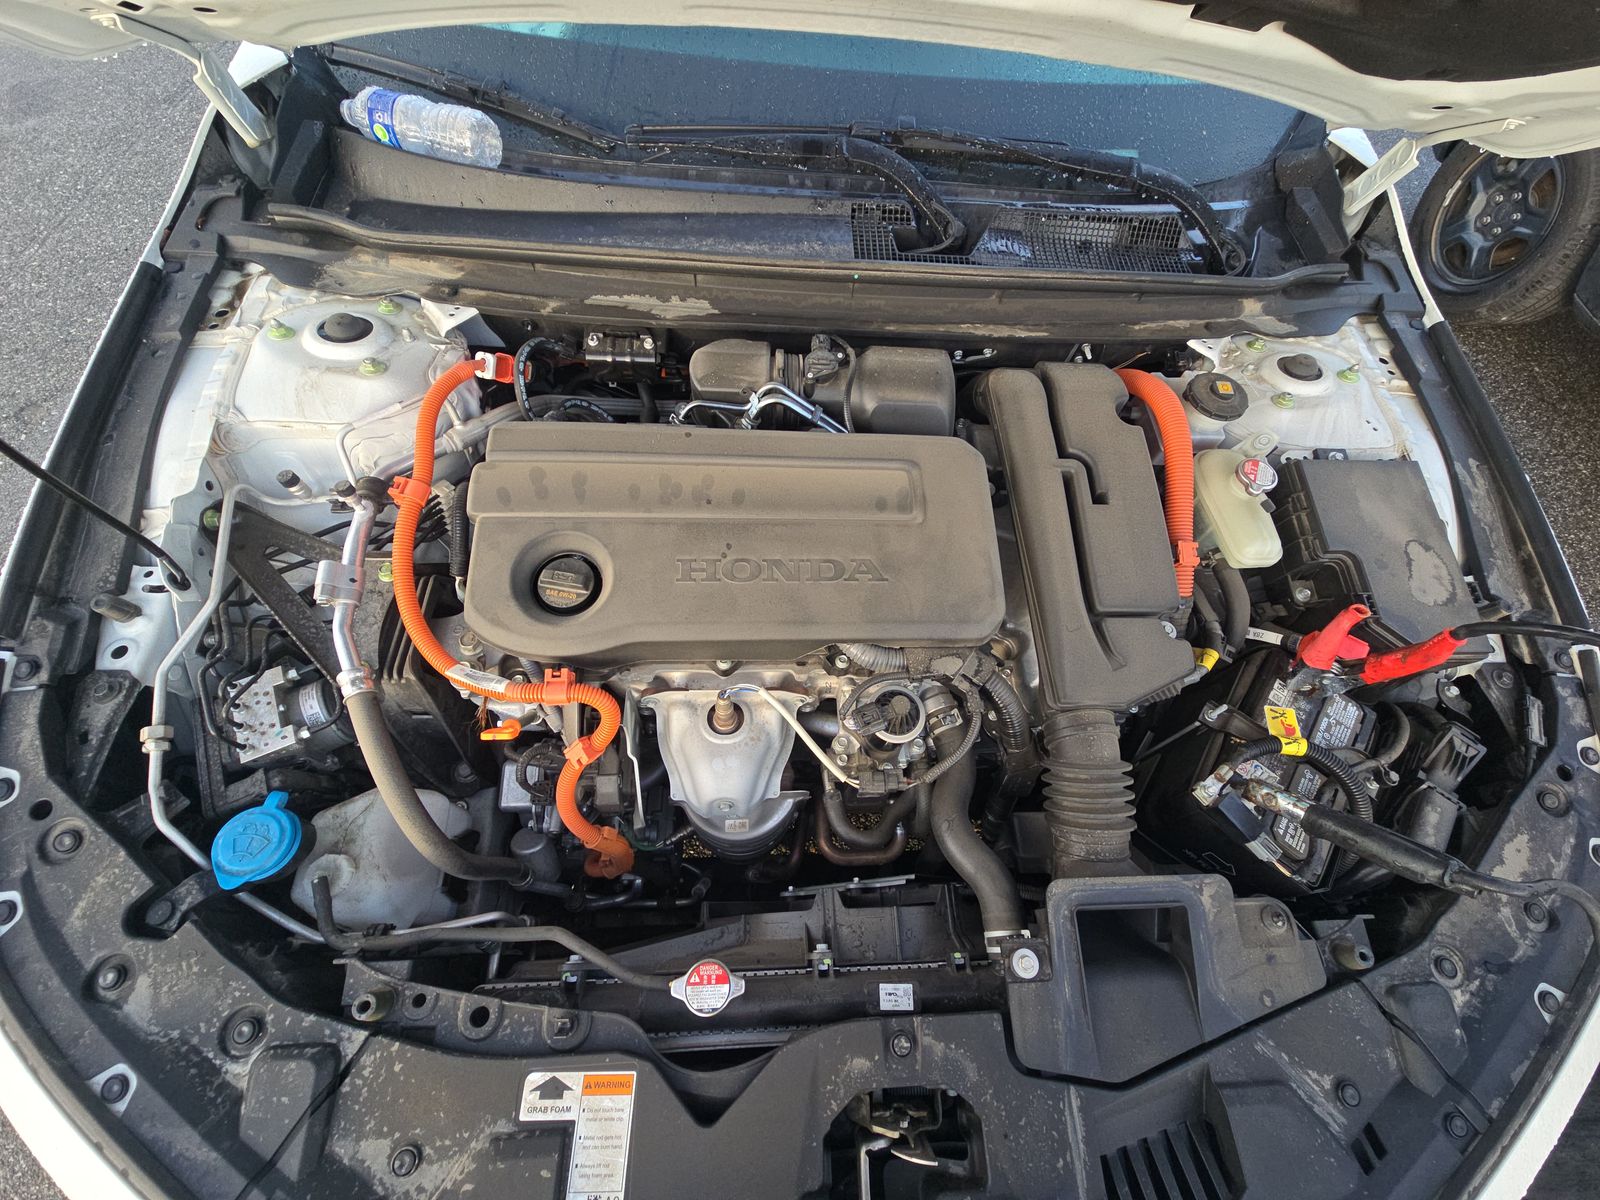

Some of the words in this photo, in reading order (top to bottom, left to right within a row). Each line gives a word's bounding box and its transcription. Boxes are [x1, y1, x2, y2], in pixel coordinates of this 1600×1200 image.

[675, 557, 889, 583] HONDA
[593, 1081, 631, 1089] WARNING
[527, 1106, 549, 1114] GRAB
